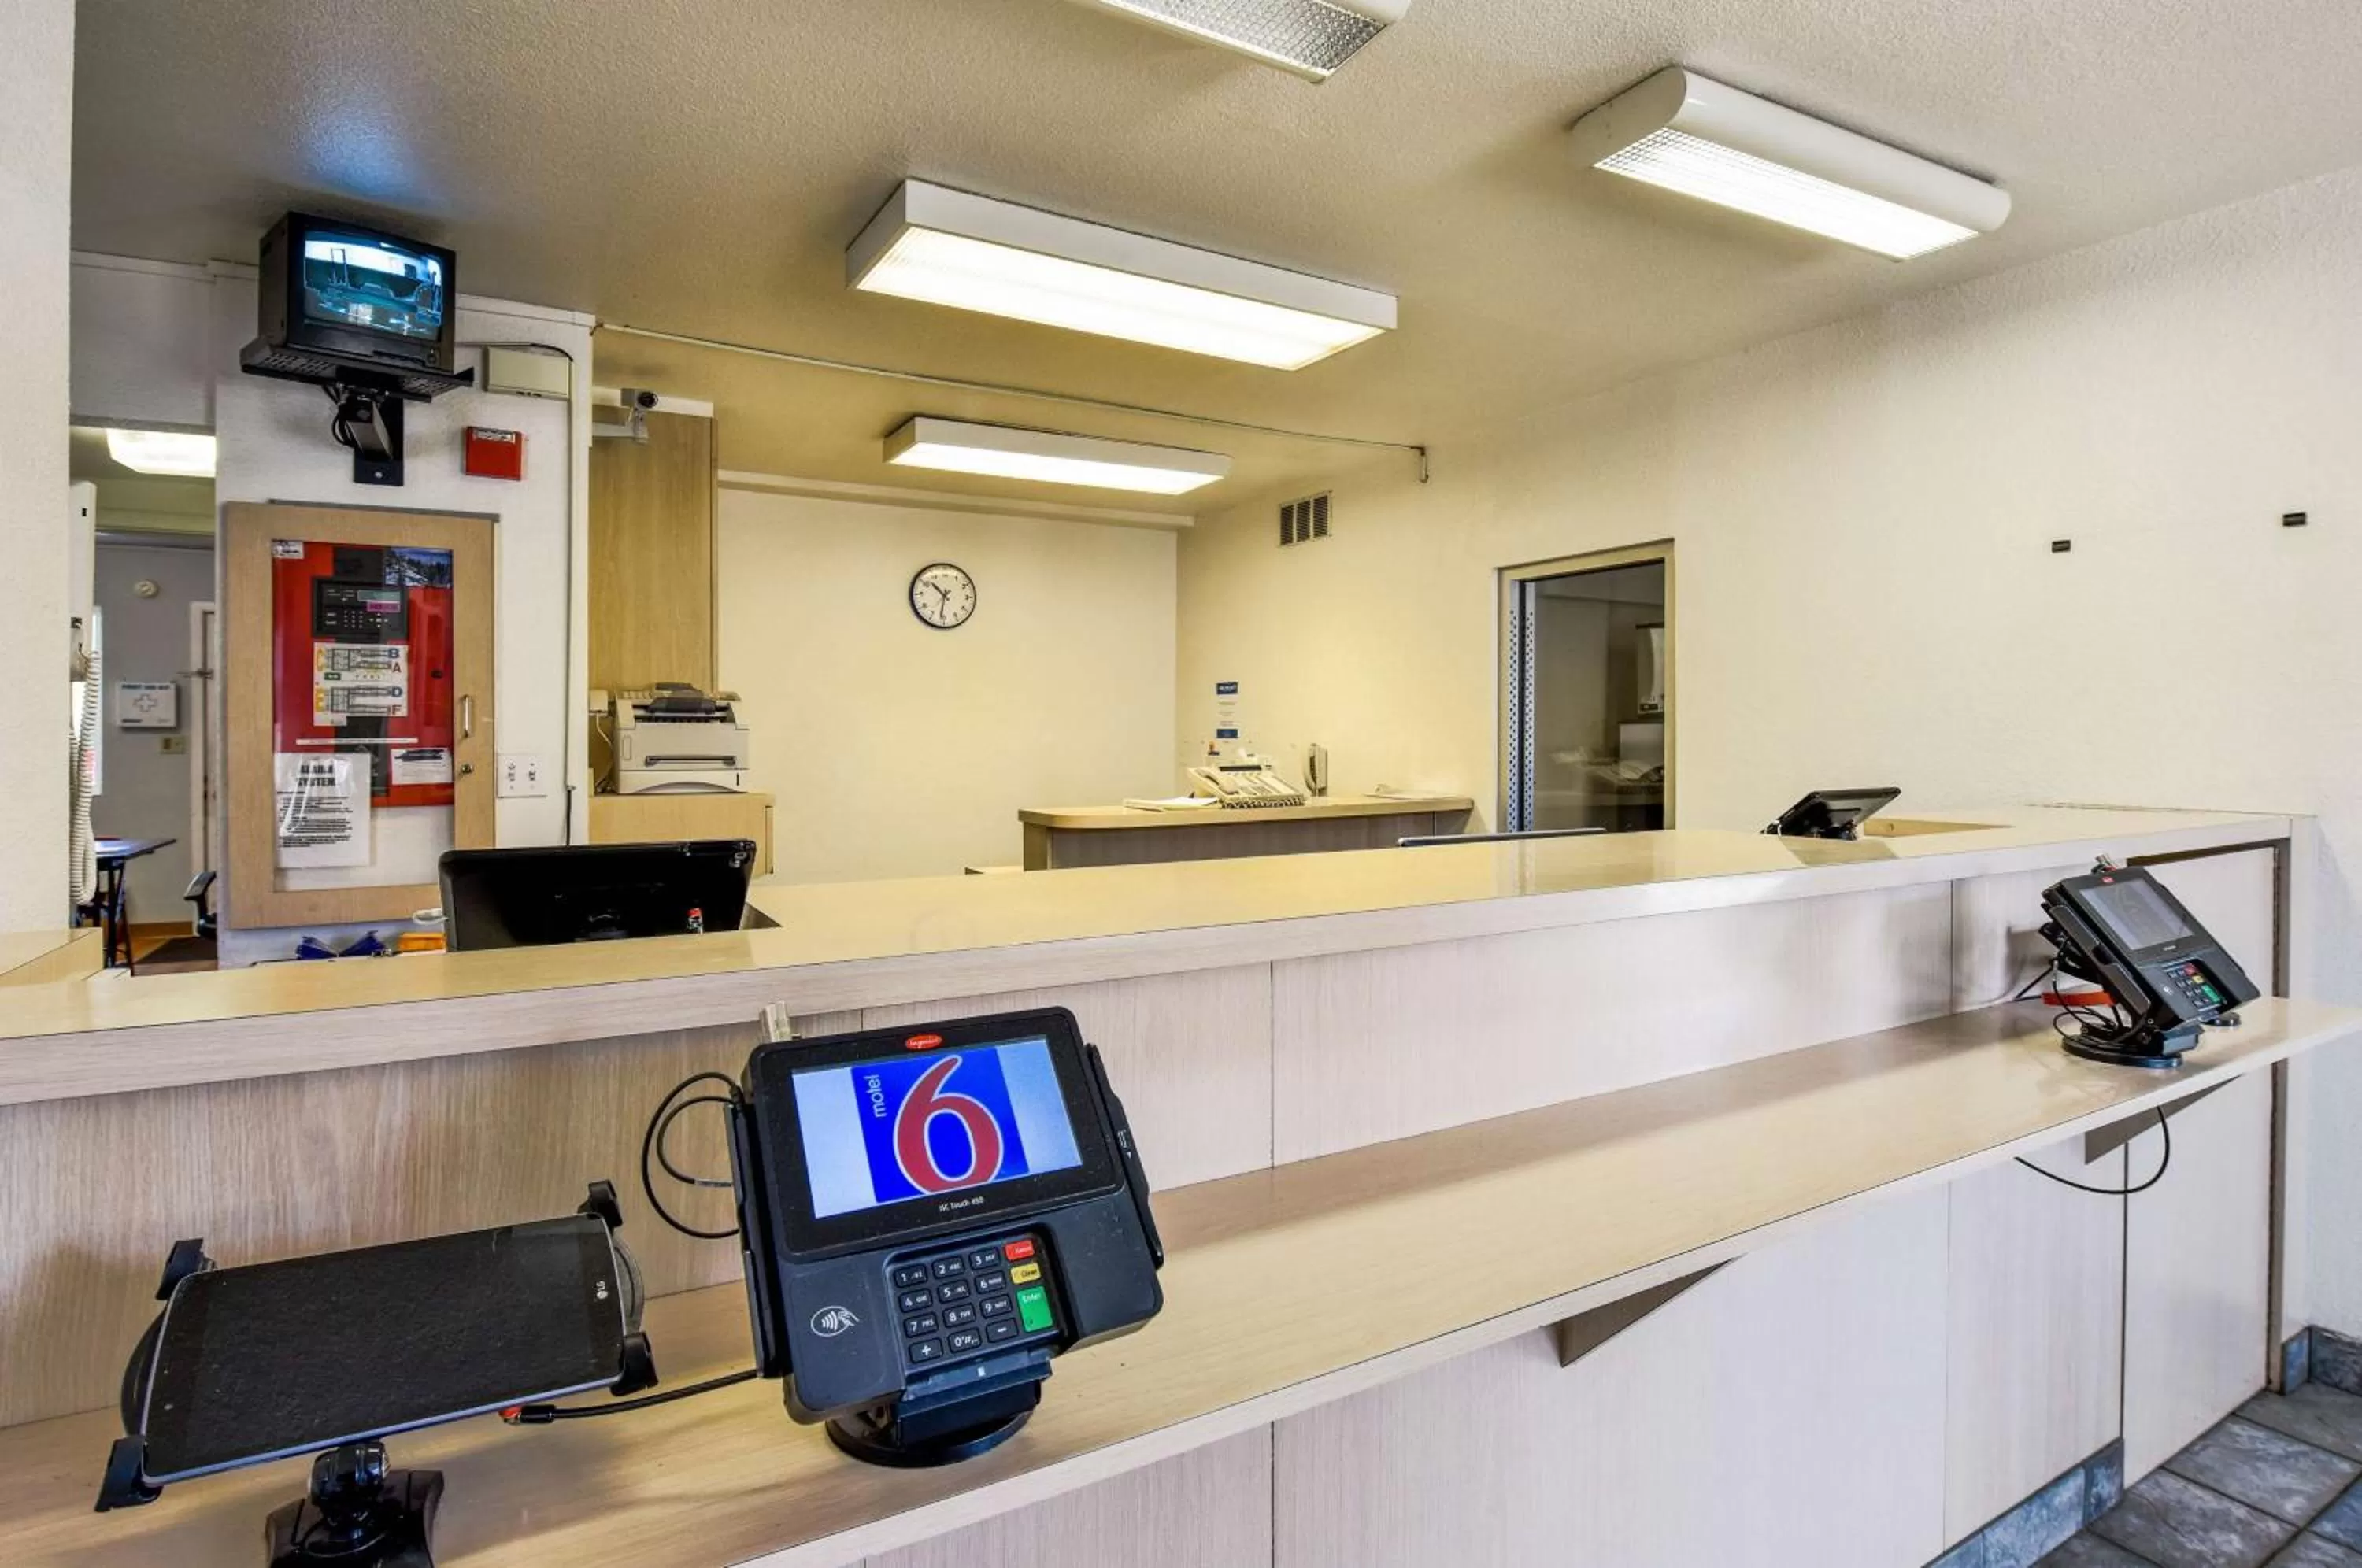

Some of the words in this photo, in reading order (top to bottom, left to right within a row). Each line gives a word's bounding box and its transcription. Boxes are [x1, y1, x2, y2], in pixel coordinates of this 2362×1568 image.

[388, 649, 399, 659] B
[393, 663, 402, 673] A
[391, 686, 403, 698] D
[392, 704, 402, 716] F
[864, 1074, 887, 1119] motel
[893, 1054, 1005, 1195] 6
[975, 1255, 983, 1266] 3
[938, 1263, 946, 1274] 2
[900, 1272, 908, 1282] 1
[980, 1278, 988, 1289] 6
[944, 1287, 952, 1298] 5
[985, 1303, 993, 1313] 9
[949, 1312, 957, 1322] 8
[909, 1322, 918, 1333] 7
